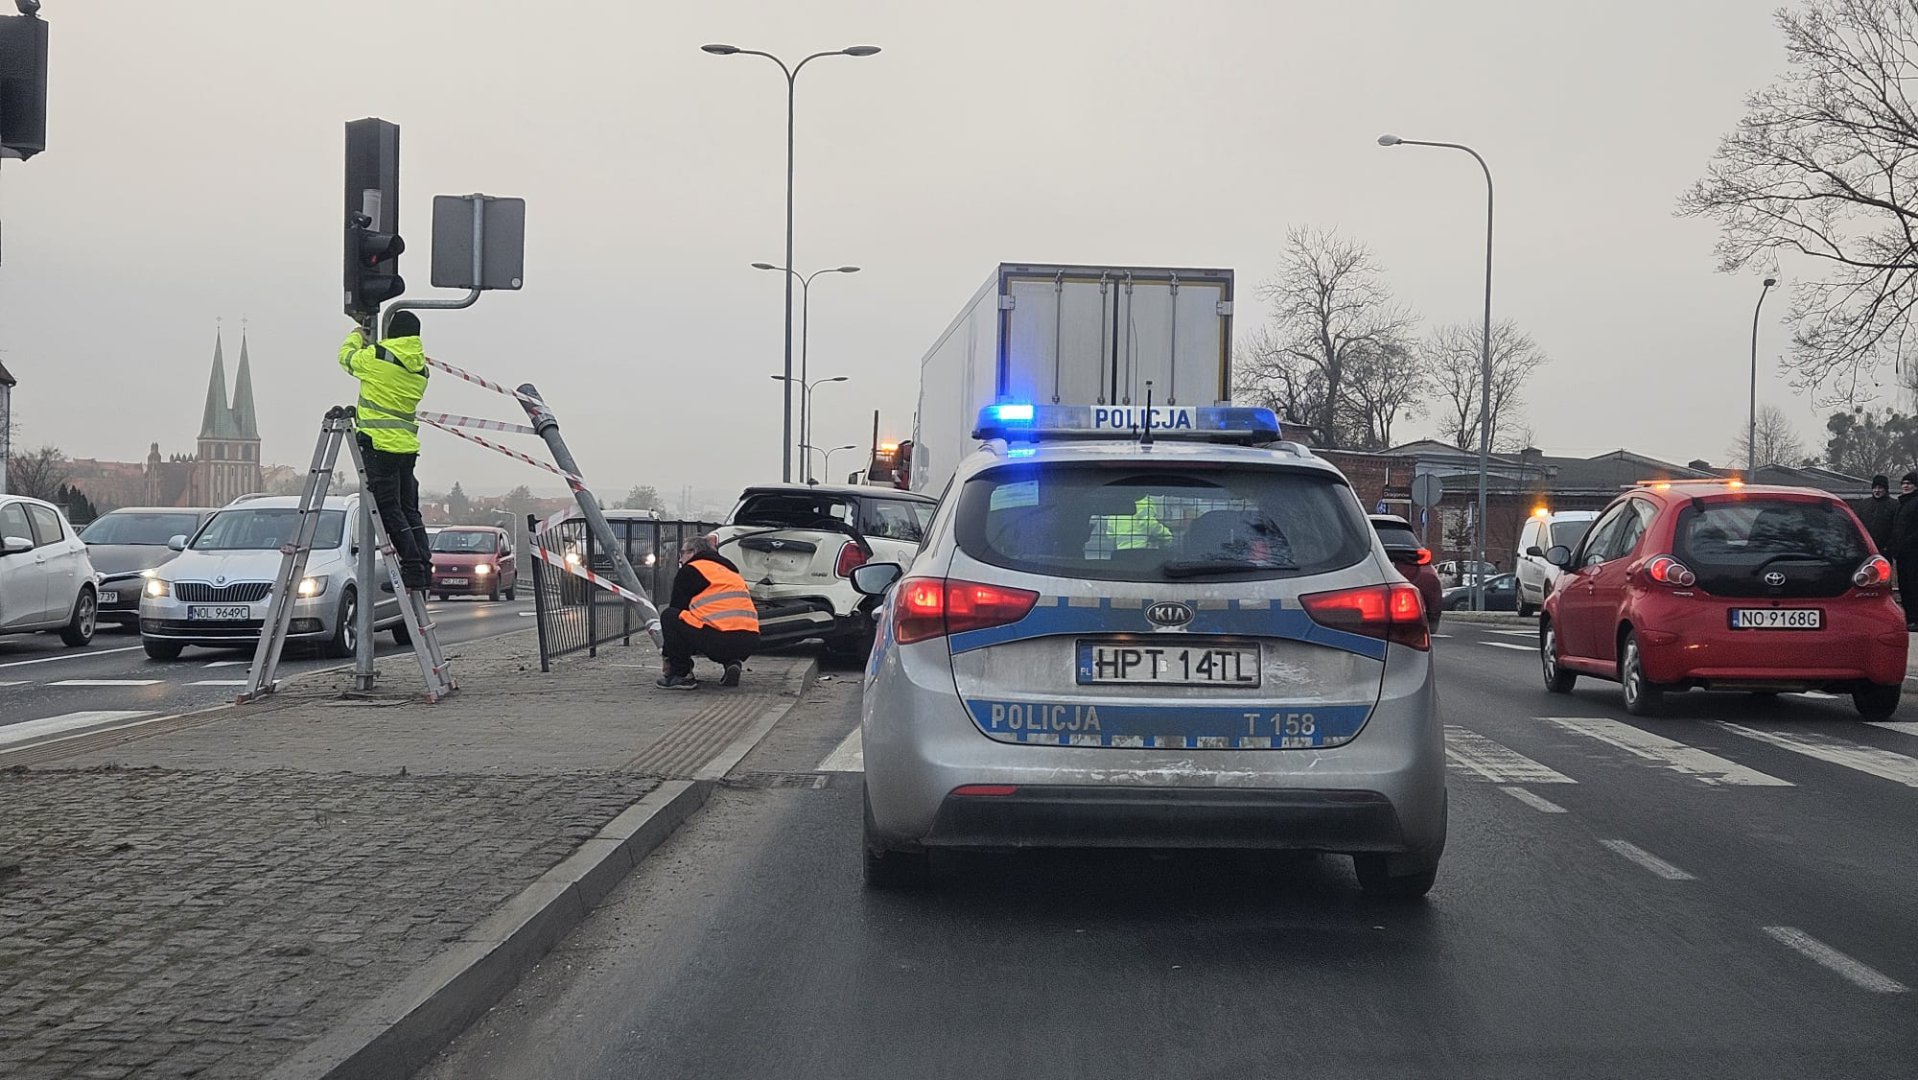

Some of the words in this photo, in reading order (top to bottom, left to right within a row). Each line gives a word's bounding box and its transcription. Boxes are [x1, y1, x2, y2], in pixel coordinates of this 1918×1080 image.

[1095, 408, 1191, 429] POLICJA
[193, 607, 212, 618] NOL
[215, 607, 247, 618] 9649C
[1155, 607, 1186, 620] KIA
[1742, 611, 1764, 626] NO
[1769, 611, 1817, 626] 9168G
[1080, 667, 1092, 677] PL
[1098, 648, 1164, 680] HPT
[1179, 649, 1253, 682] 14TL
[991, 703, 1101, 731] POLICJA
[1243, 713, 1260, 735] T
[1270, 713, 1315, 736] 158
